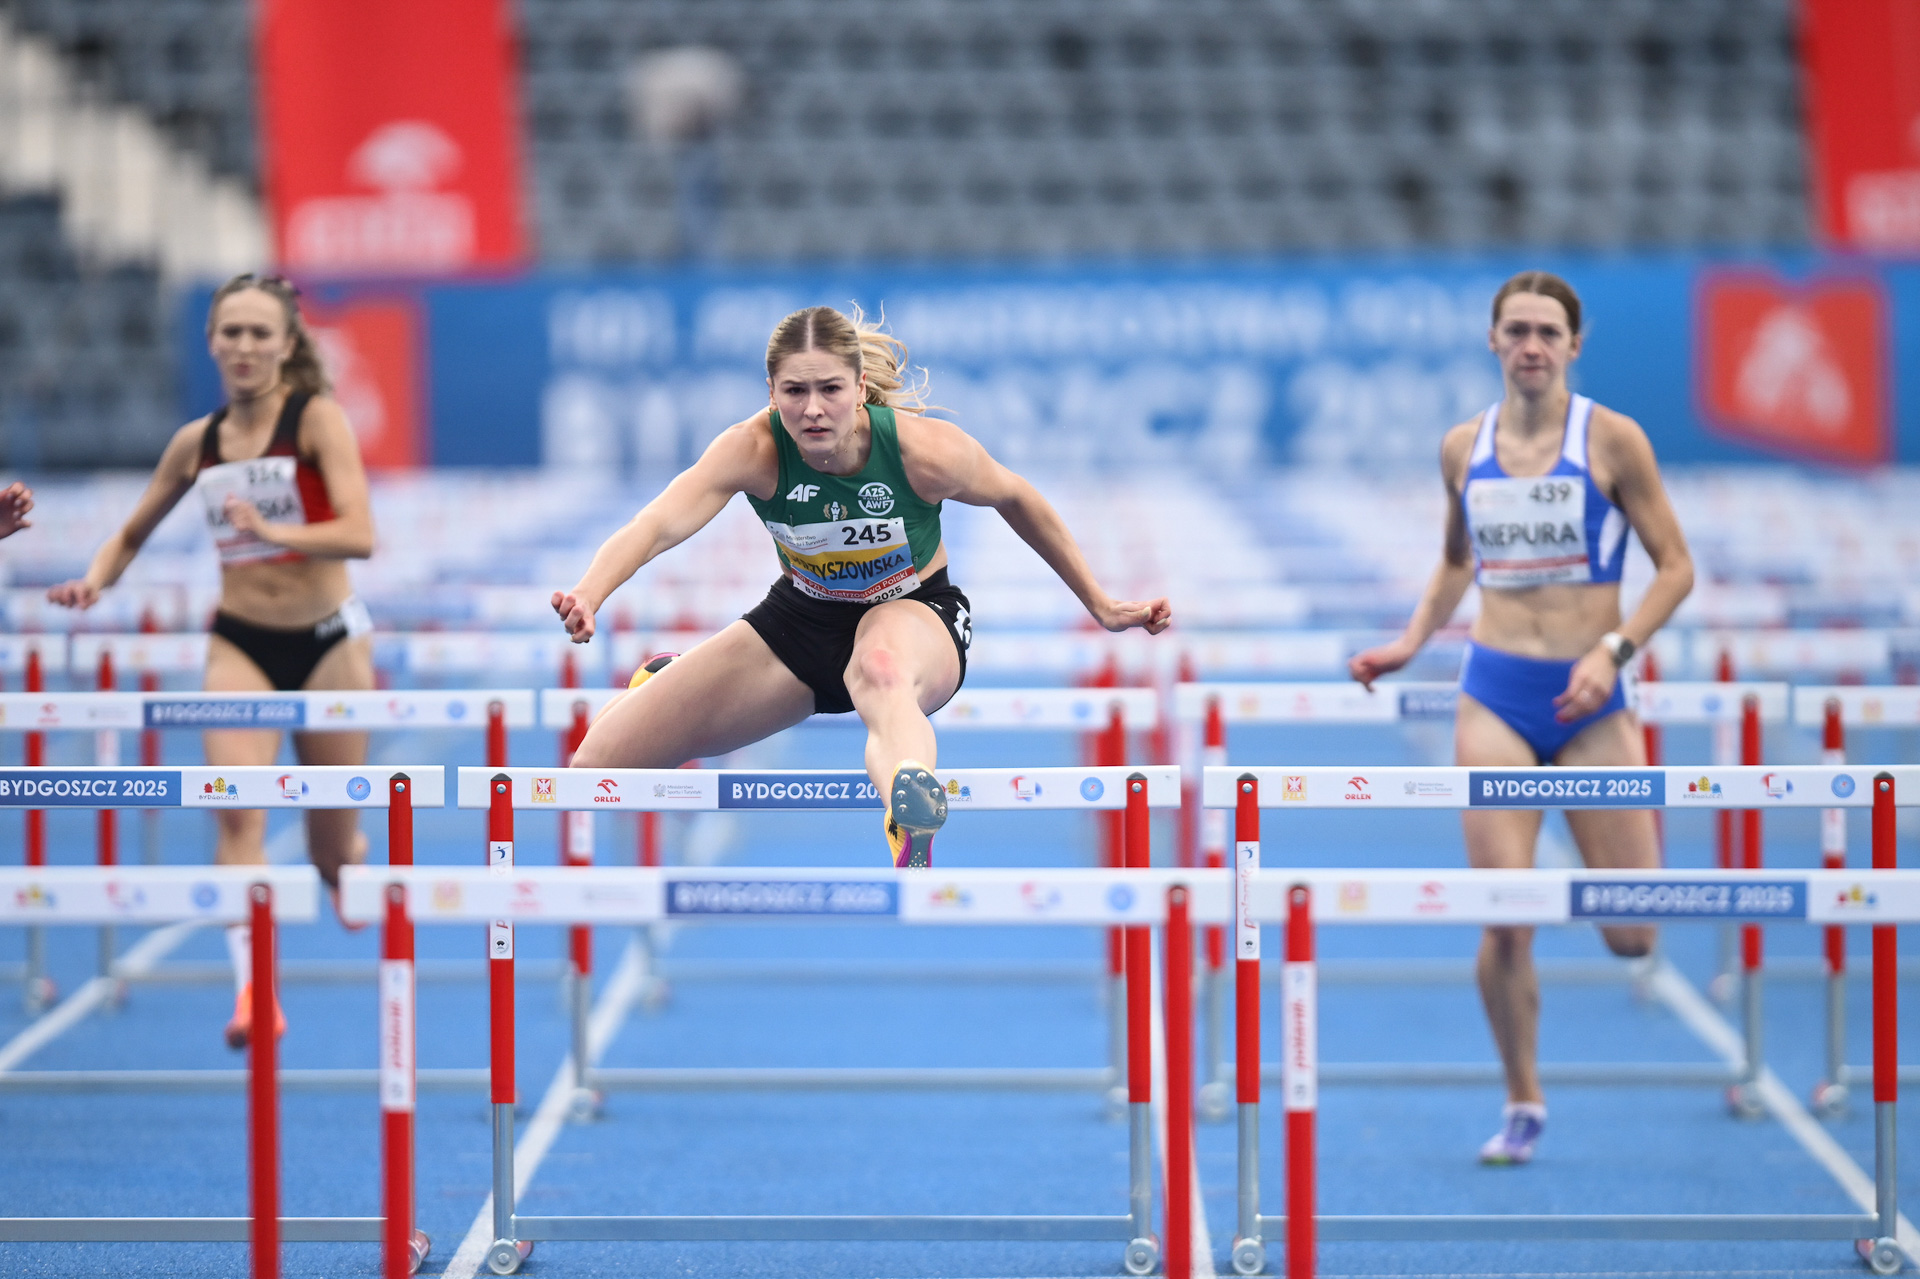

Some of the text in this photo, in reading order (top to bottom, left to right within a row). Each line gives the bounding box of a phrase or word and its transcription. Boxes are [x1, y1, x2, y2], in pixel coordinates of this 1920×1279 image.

[786, 483, 821, 502] 4F
[865, 487, 886, 498] AZS
[1529, 483, 1571, 503] 439
[865, 500, 889, 509] AWF
[841, 523, 892, 545] 245
[786, 552, 905, 581] RZYSZOWSKA
[882, 570, 908, 587] Polski
[874, 584, 903, 602] 2025
[0, 780, 168, 796] BYDGOSZCZ 2025
[732, 782, 881, 799] BYDGOSZCZ 20
[1483, 779, 1652, 797] BYDGOSZCZ 2025
